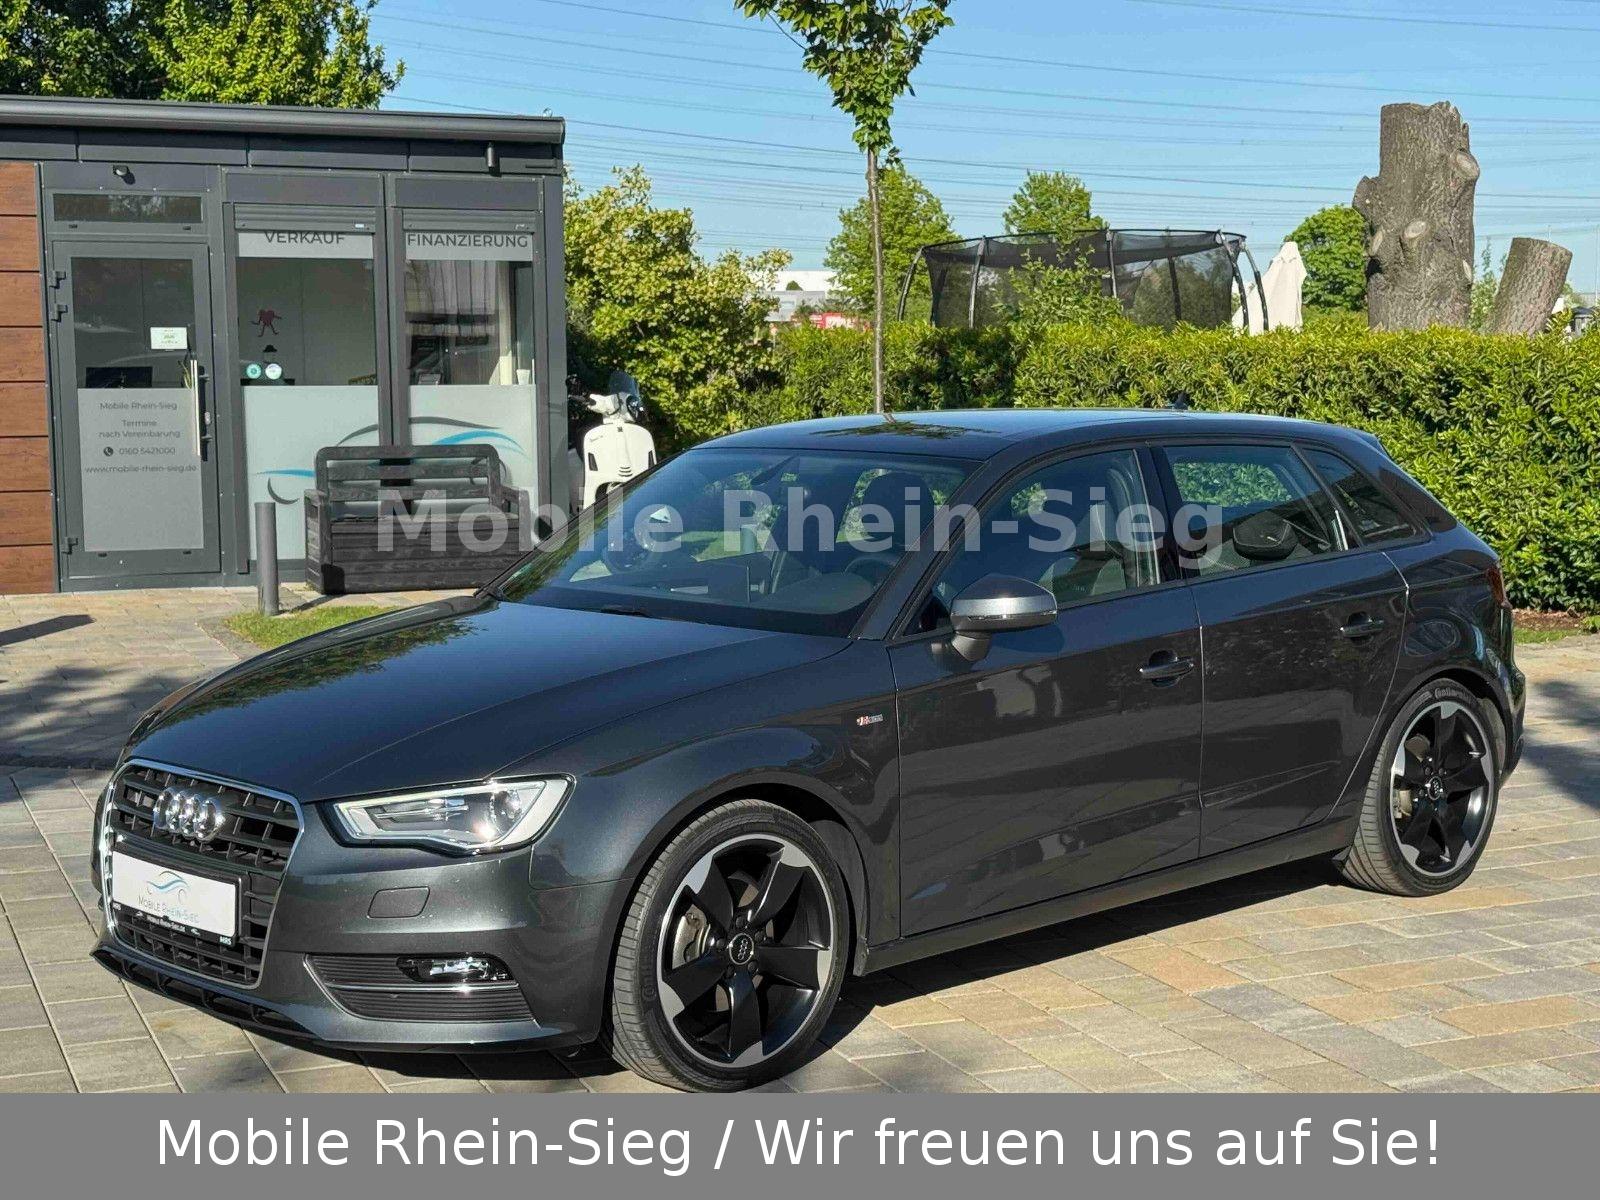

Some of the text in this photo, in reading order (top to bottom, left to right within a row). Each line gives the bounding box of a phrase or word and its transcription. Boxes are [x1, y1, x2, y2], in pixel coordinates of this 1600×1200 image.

[263, 231, 346, 244] VERKAUF
[407, 233, 529, 248] FINANZIERUNG
[99, 402, 178, 411] Mobile Rhein-Sieg
[121, 419, 158, 427] Termine
[98, 430, 181, 439] nach Vereinbarung
[84, 464, 198, 474] www.mobile-rhein-sieg.de
